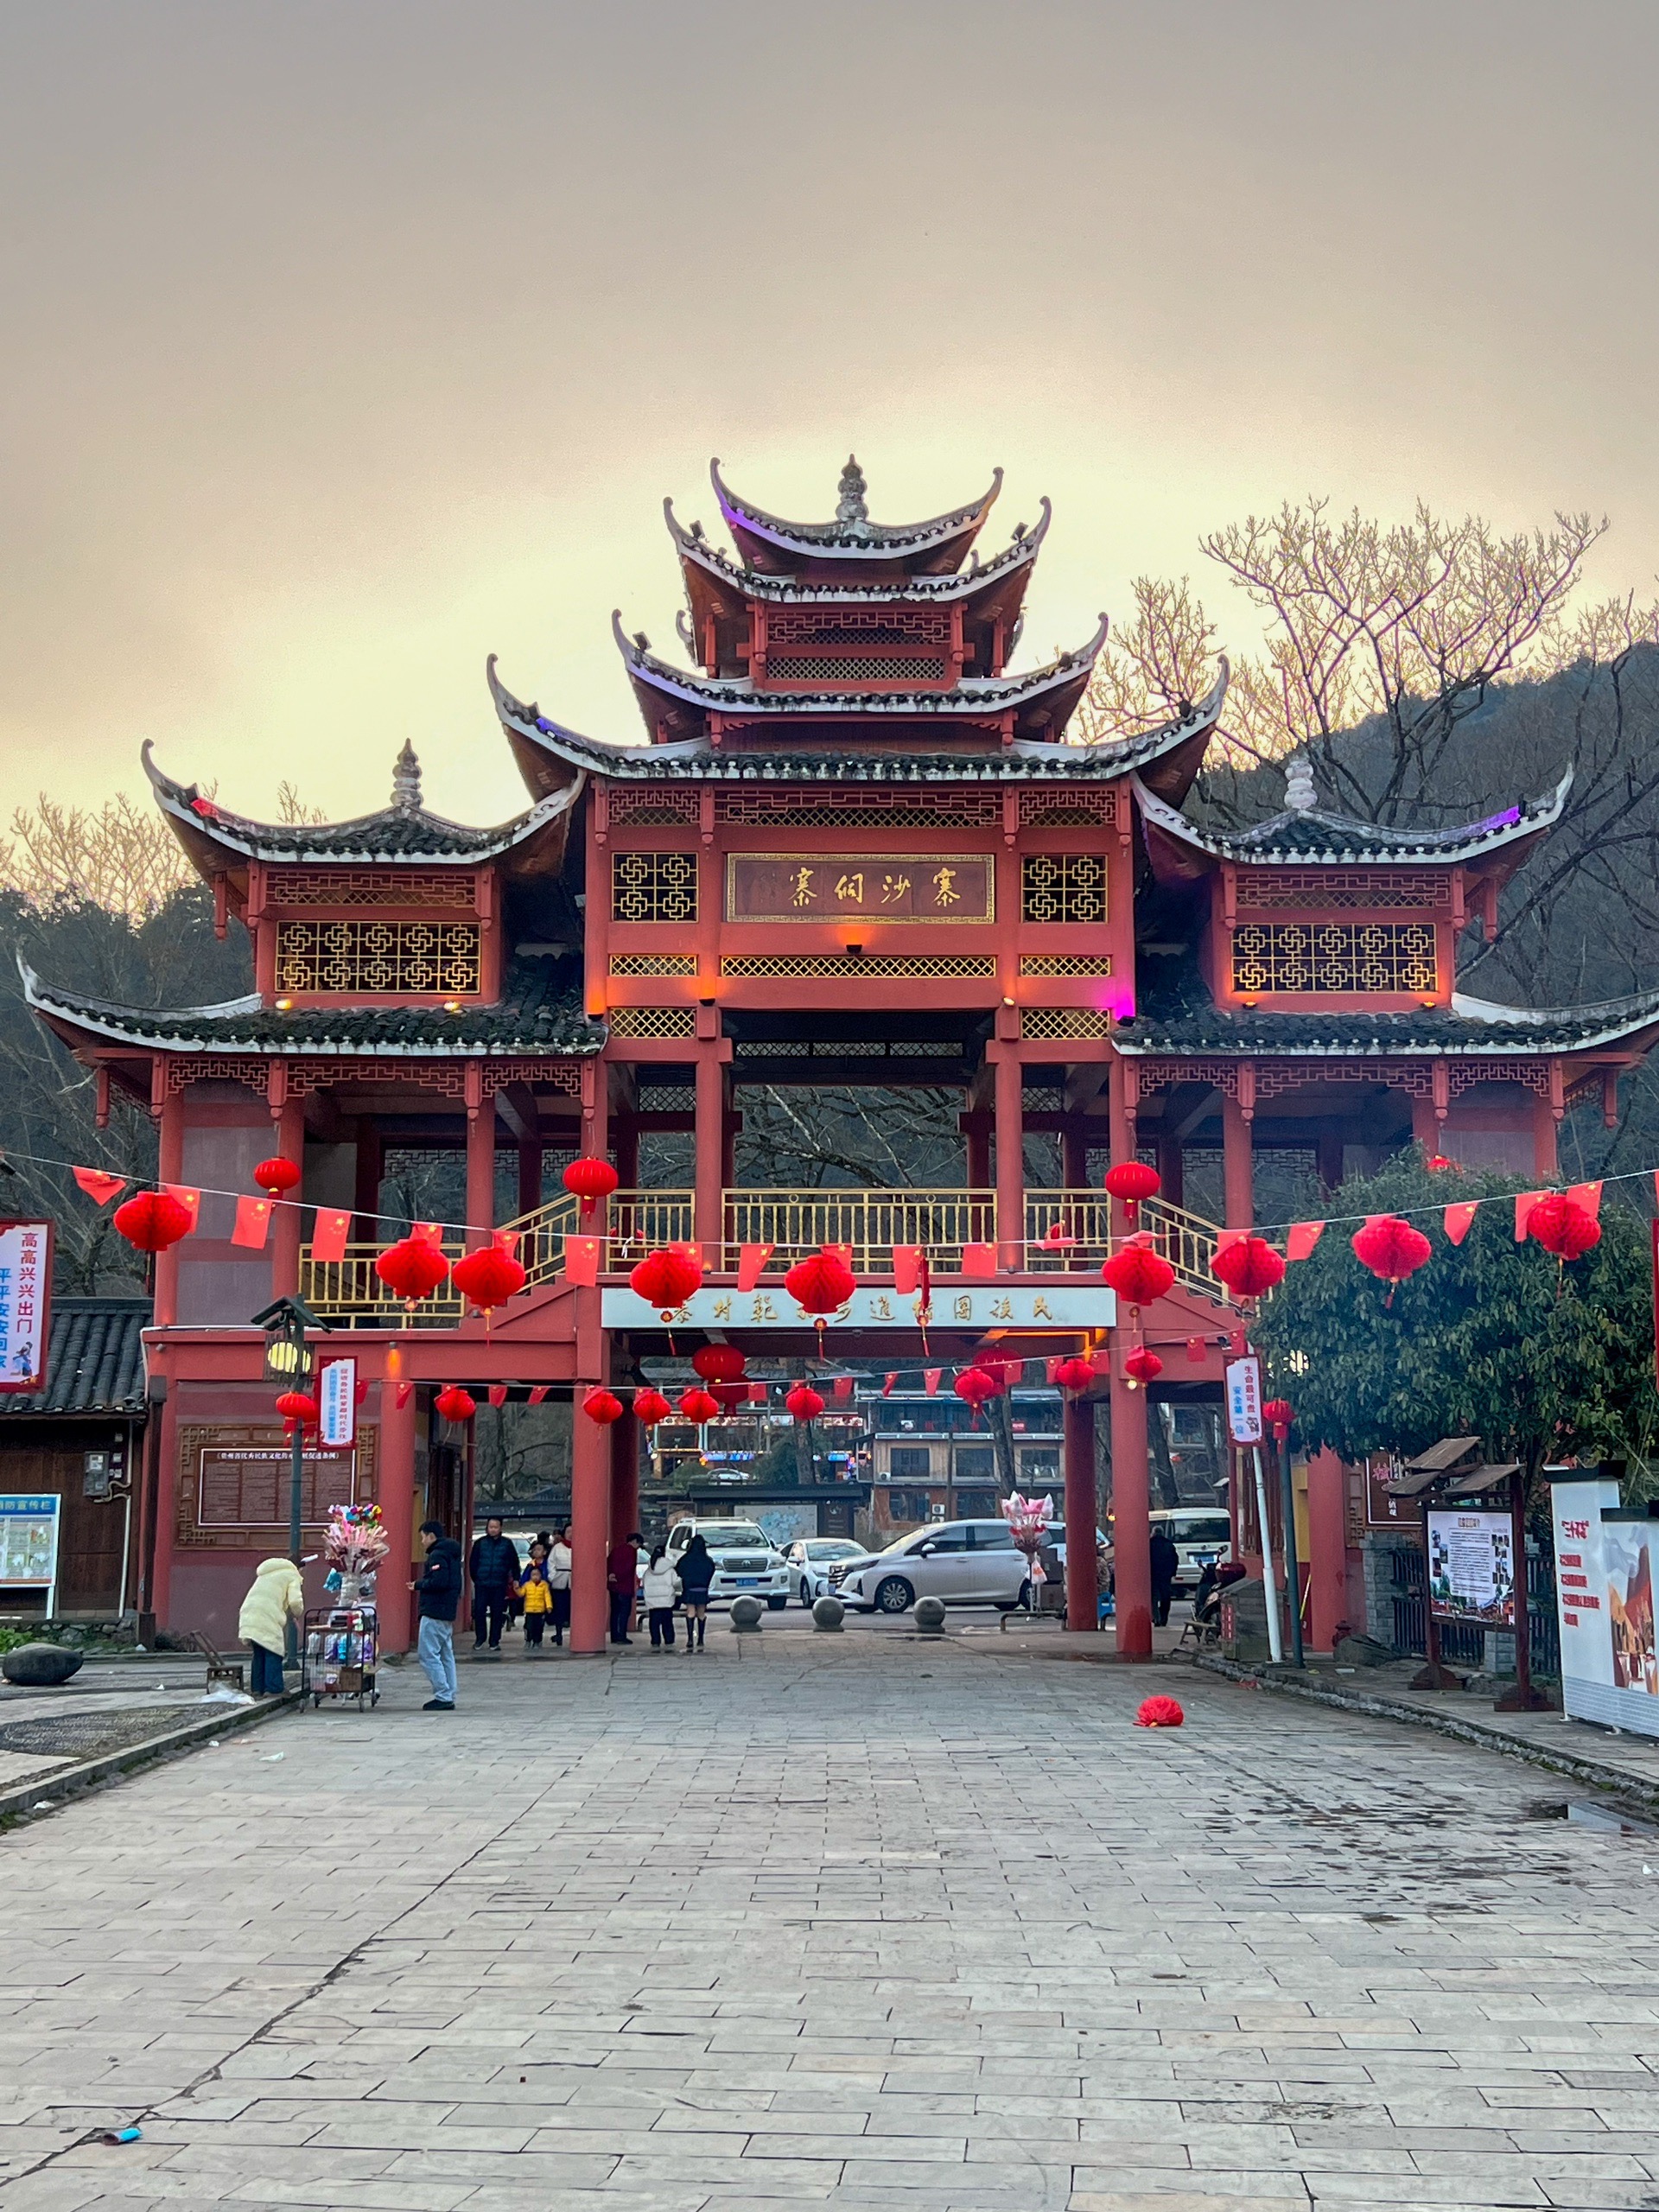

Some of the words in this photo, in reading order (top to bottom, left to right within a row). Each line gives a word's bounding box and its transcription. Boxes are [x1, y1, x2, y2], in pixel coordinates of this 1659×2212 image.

[16, 1233, 38, 1333] 高高兴兴出门
[1232, 1386, 1243, 1434] 安全第一位
[1244, 1365, 1255, 1413] 生命最可贵
